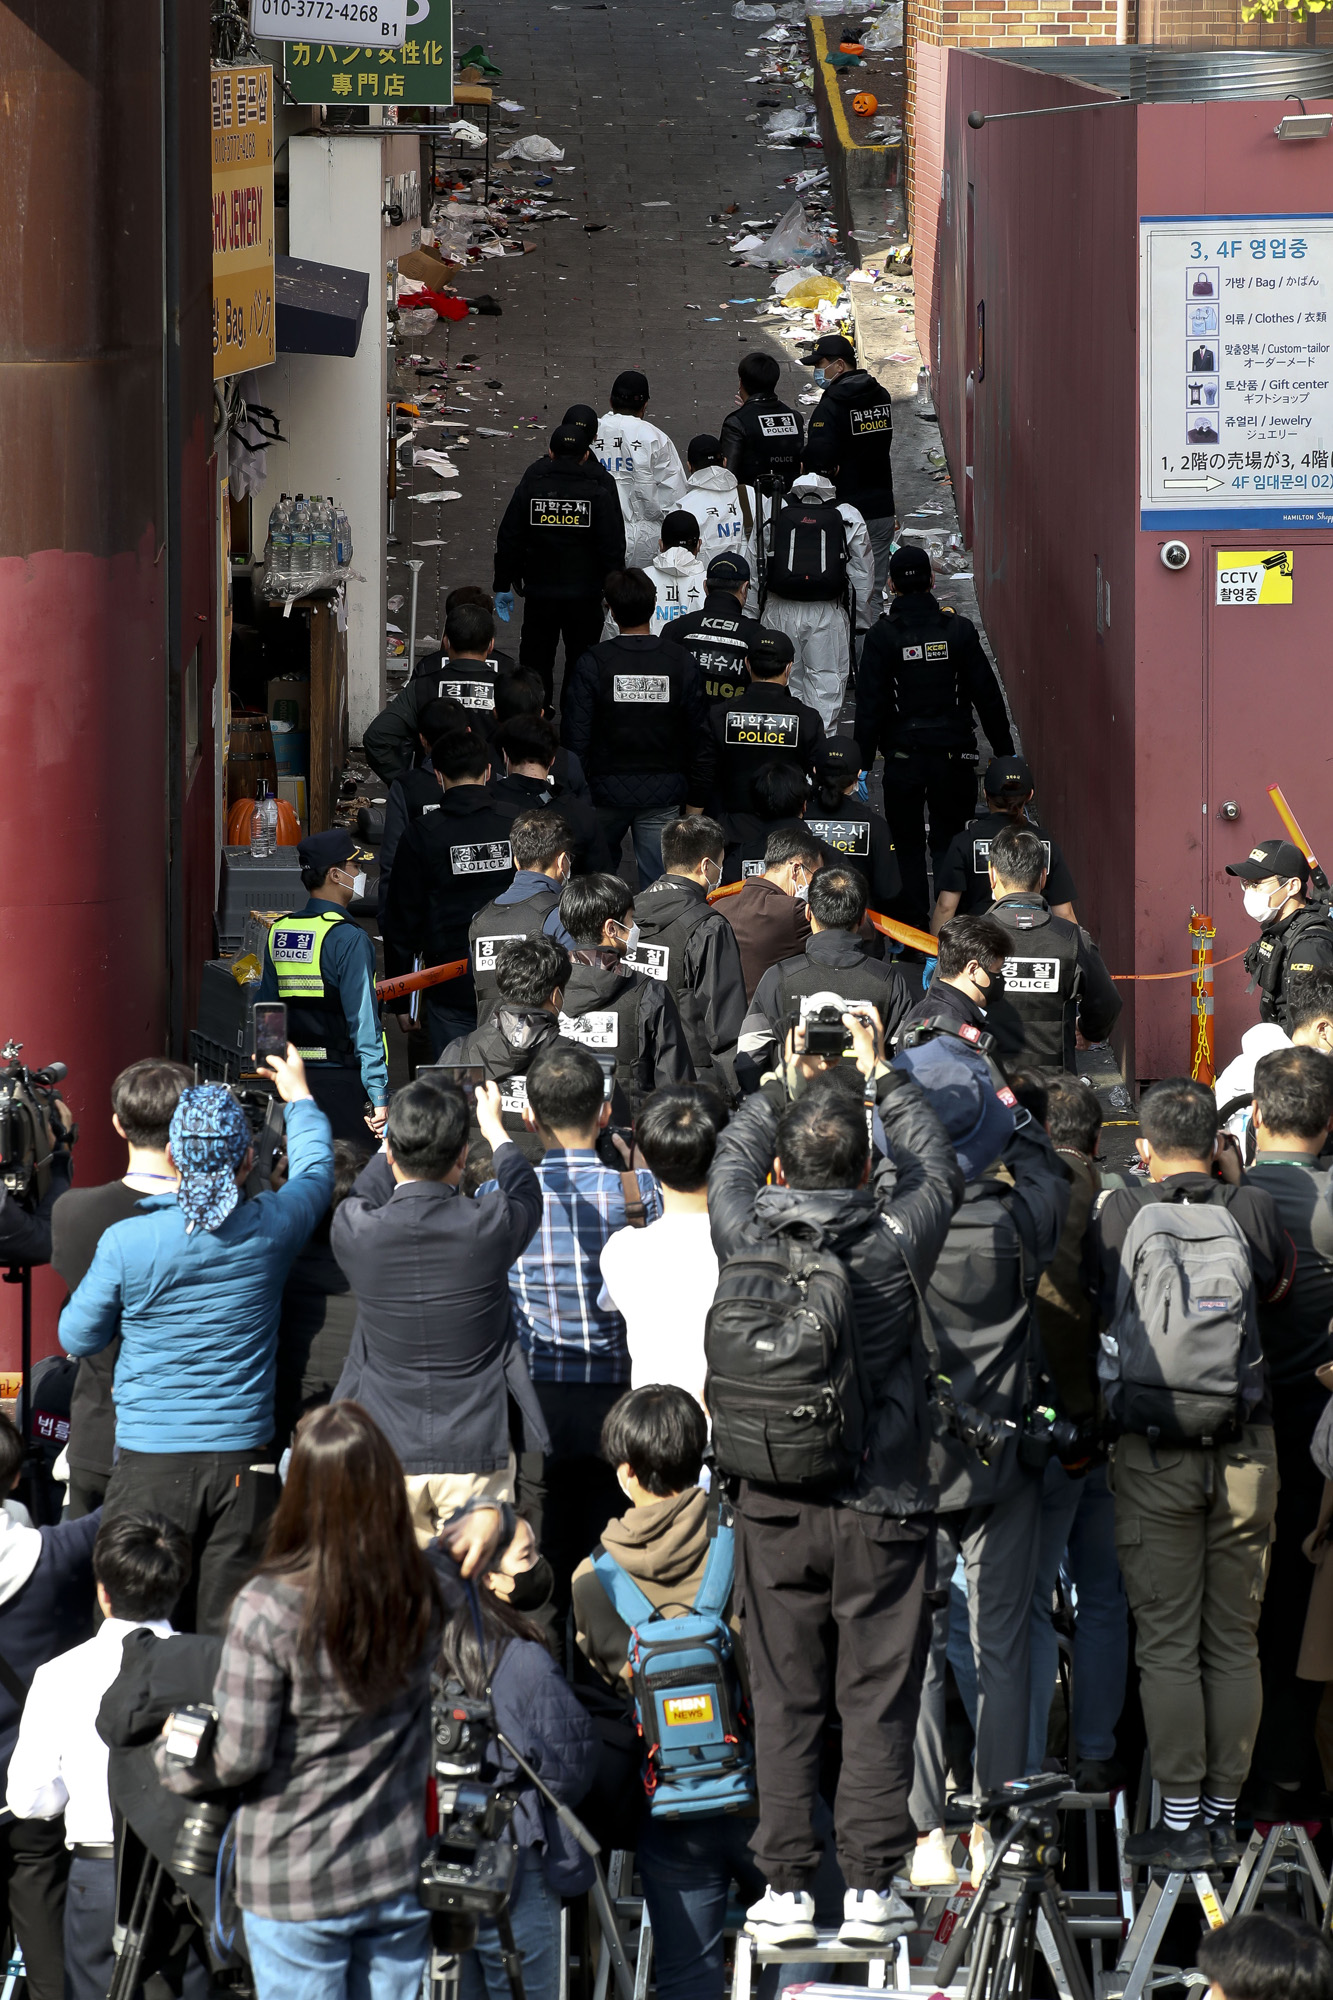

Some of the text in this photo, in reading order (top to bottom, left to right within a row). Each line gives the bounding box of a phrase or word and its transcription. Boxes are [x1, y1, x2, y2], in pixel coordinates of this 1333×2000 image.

[262, 0, 378, 22] 010-3772-4268
[381, 23, 398, 37] B1
[214, 132, 255, 164] 010-3772-4268
[1190, 238, 1308, 261] 3, 4F 영업중
[1225, 278, 1245, 289] 가방
[1255, 278, 1276, 289] Bag
[1286, 275, 1319, 287] かばん
[1225, 313, 1245, 325] 의류
[1255, 313, 1294, 324] Clothes
[1304, 311, 1327, 323] 衣類
[1225, 344, 1259, 356] 맞춤양복
[1267, 343, 1330, 354] Custom-tailor
[1244, 357, 1316, 368] オーダーメード
[1225, 380, 1258, 391] 토산품
[1269, 379, 1290, 390] Gift
[1292, 381, 1329, 390] center
[1244, 392, 1311, 404] ギフトショップ
[860, 419, 888, 432] POLICE
[1225, 416, 1258, 428] 쥬얼리
[1268, 415, 1313, 428] Jewelry
[1247, 430, 1298, 440] ジュエリー
[600, 457, 634, 472] NFS
[1231, 476, 1250, 489] 4F
[1253, 474, 1308, 490] 임대문의
[540, 514, 580, 525] POLICE
[717, 521, 741, 538] NF
[1220, 571, 1258, 584] CCTV
[1220, 588, 1258, 602] 촬영중
[701, 617, 740, 632] KCSI
[462, 698, 489, 706] LICE
[620, 692, 663, 700] POLICE
[731, 714, 793, 732] 과학수사
[738, 730, 785, 744] POLICE
[460, 859, 505, 871] POLICE
[277, 933, 310, 949] 경찰
[275, 950, 307, 960] POLICE
[1000, 962, 1052, 979] 경찰
[1290, 963, 1314, 972] KCSI
[1008, 980, 1050, 989] OLICE
[668, 1696, 707, 1712] MBN
[674, 1710, 703, 1720] NEWS
